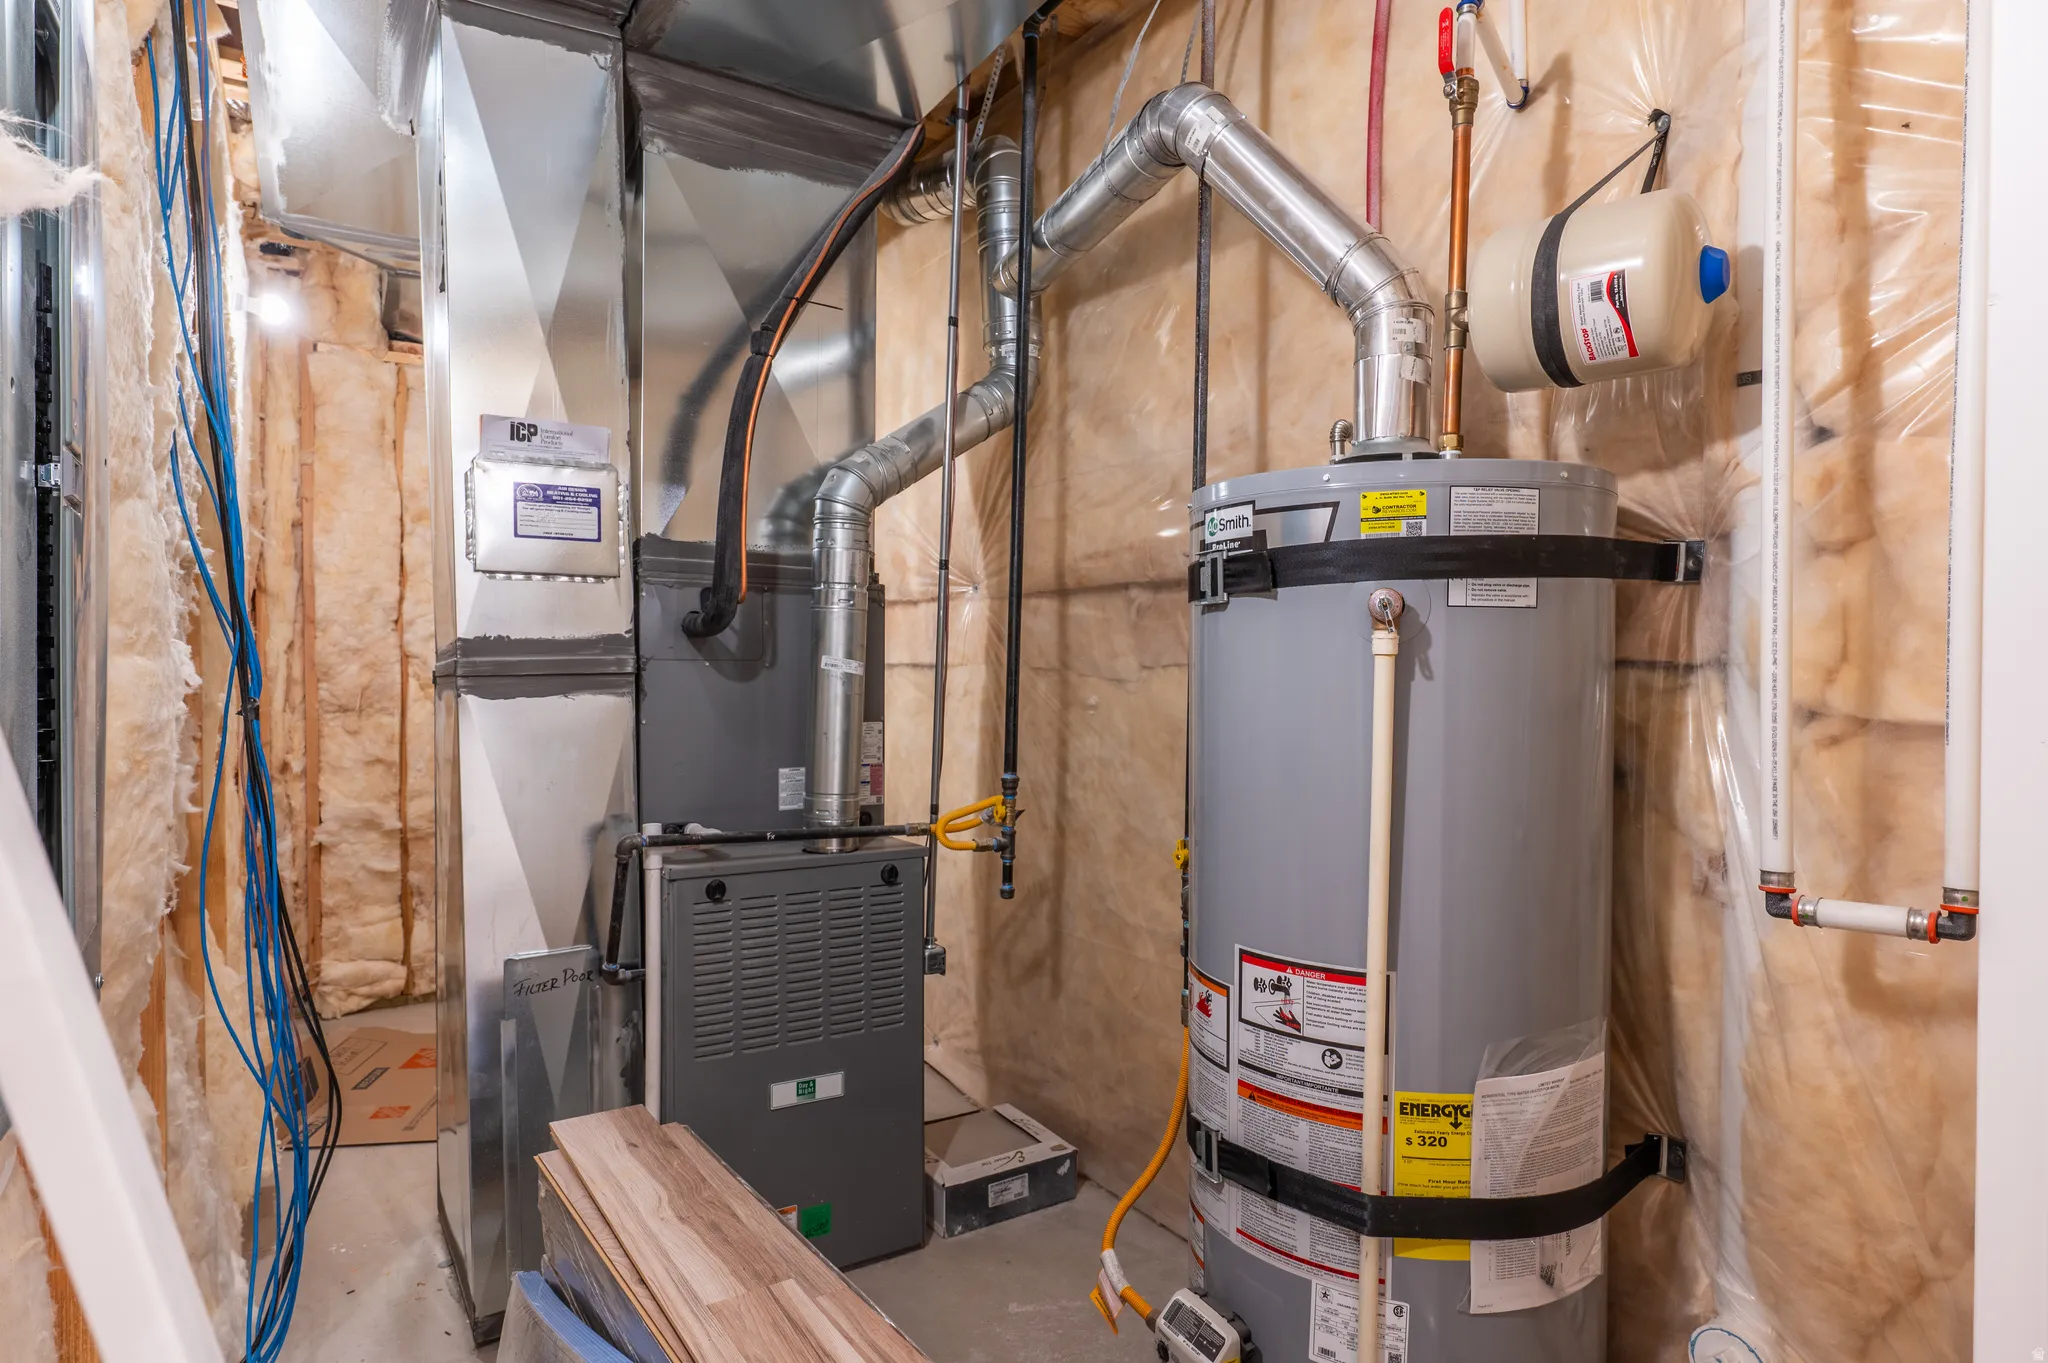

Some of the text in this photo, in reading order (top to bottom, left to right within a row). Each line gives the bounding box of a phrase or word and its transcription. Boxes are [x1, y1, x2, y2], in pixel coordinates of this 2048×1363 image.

[510, 421, 538, 442] ICP
[1219, 514, 1249, 531] Smith
[1295, 969, 1326, 980] DANGER
[514, 978, 560, 996] FILTER
[1406, 1136, 1447, 1147] $ 320
